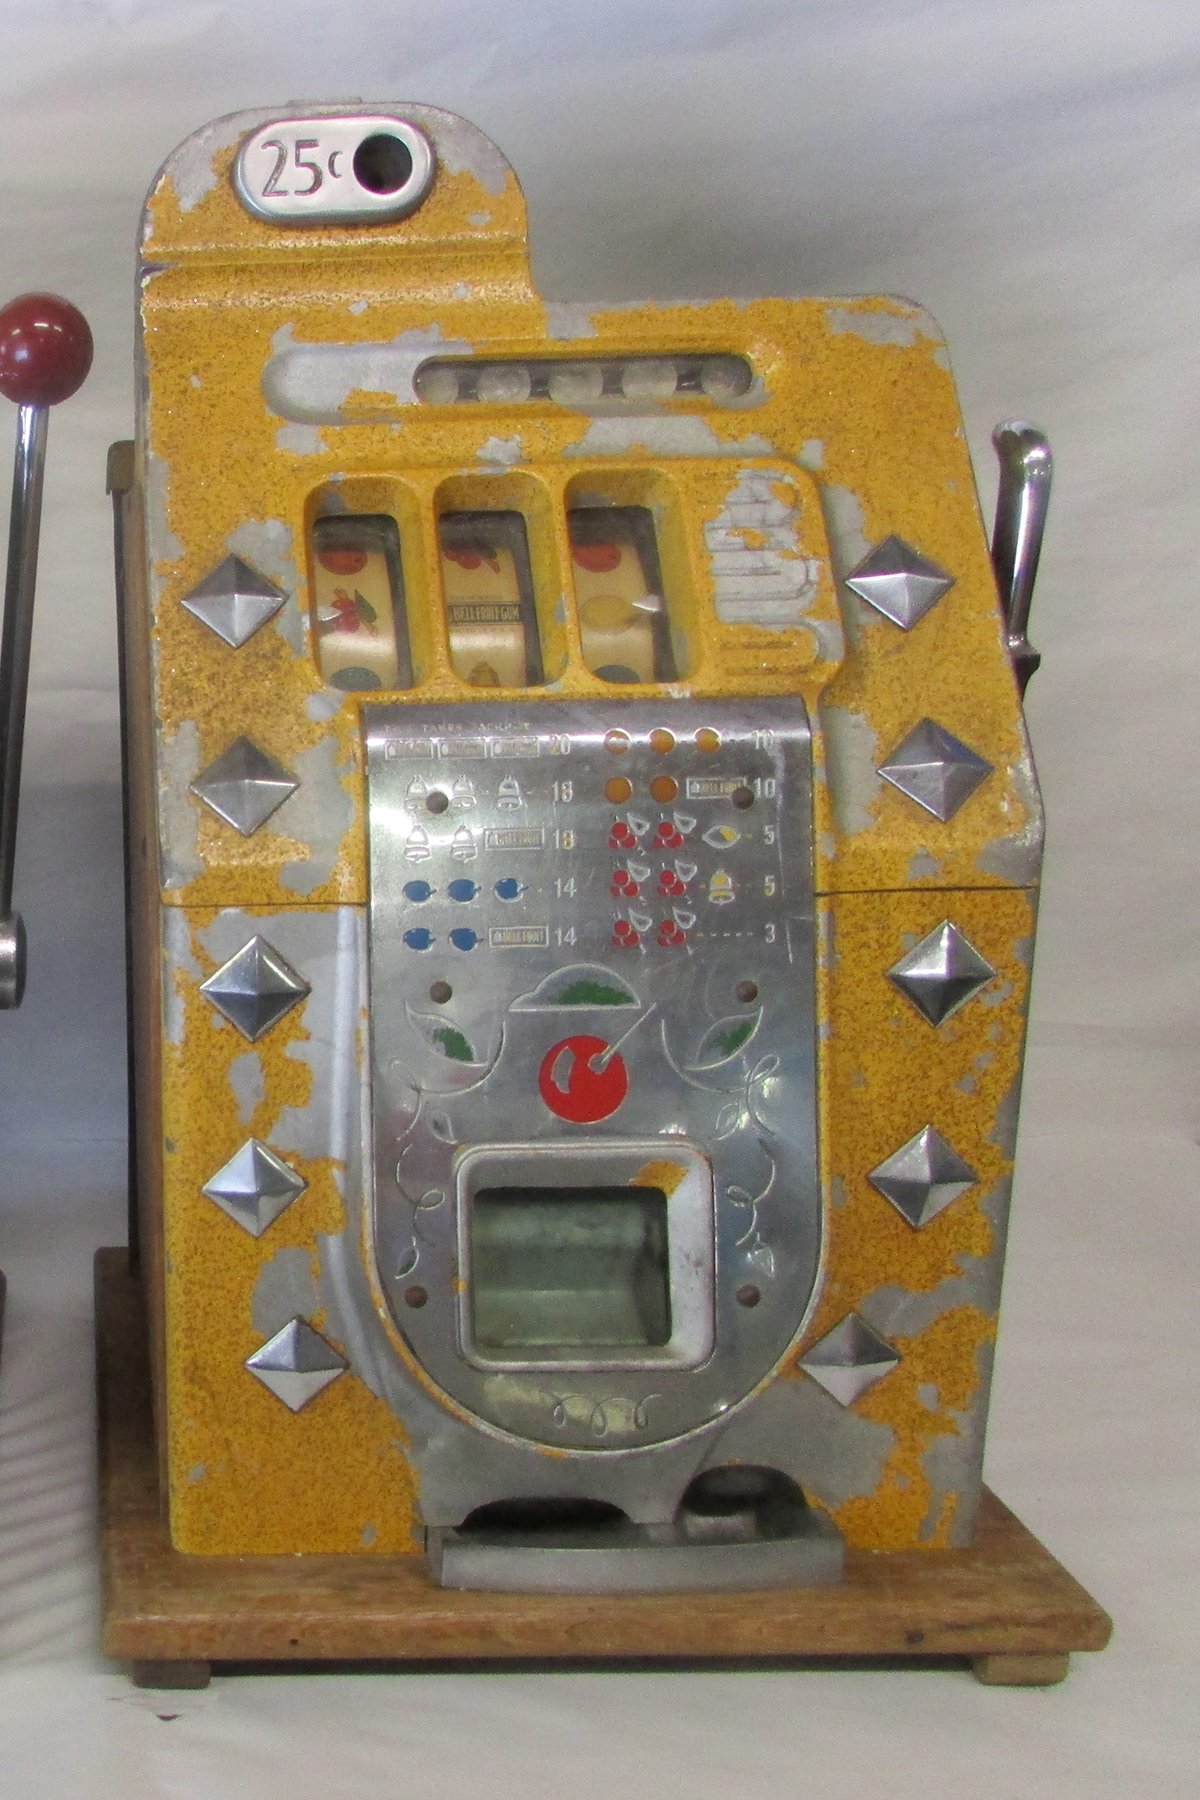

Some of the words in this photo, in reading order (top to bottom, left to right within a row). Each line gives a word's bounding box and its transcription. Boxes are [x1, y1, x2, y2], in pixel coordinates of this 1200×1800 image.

[753, 777, 776, 799] 10
[763, 825, 775, 845] 5
[553, 877, 577, 899] 14
[763, 874, 776, 897] 5
[554, 926, 578, 947] 14
[764, 922, 776, 944] 3
